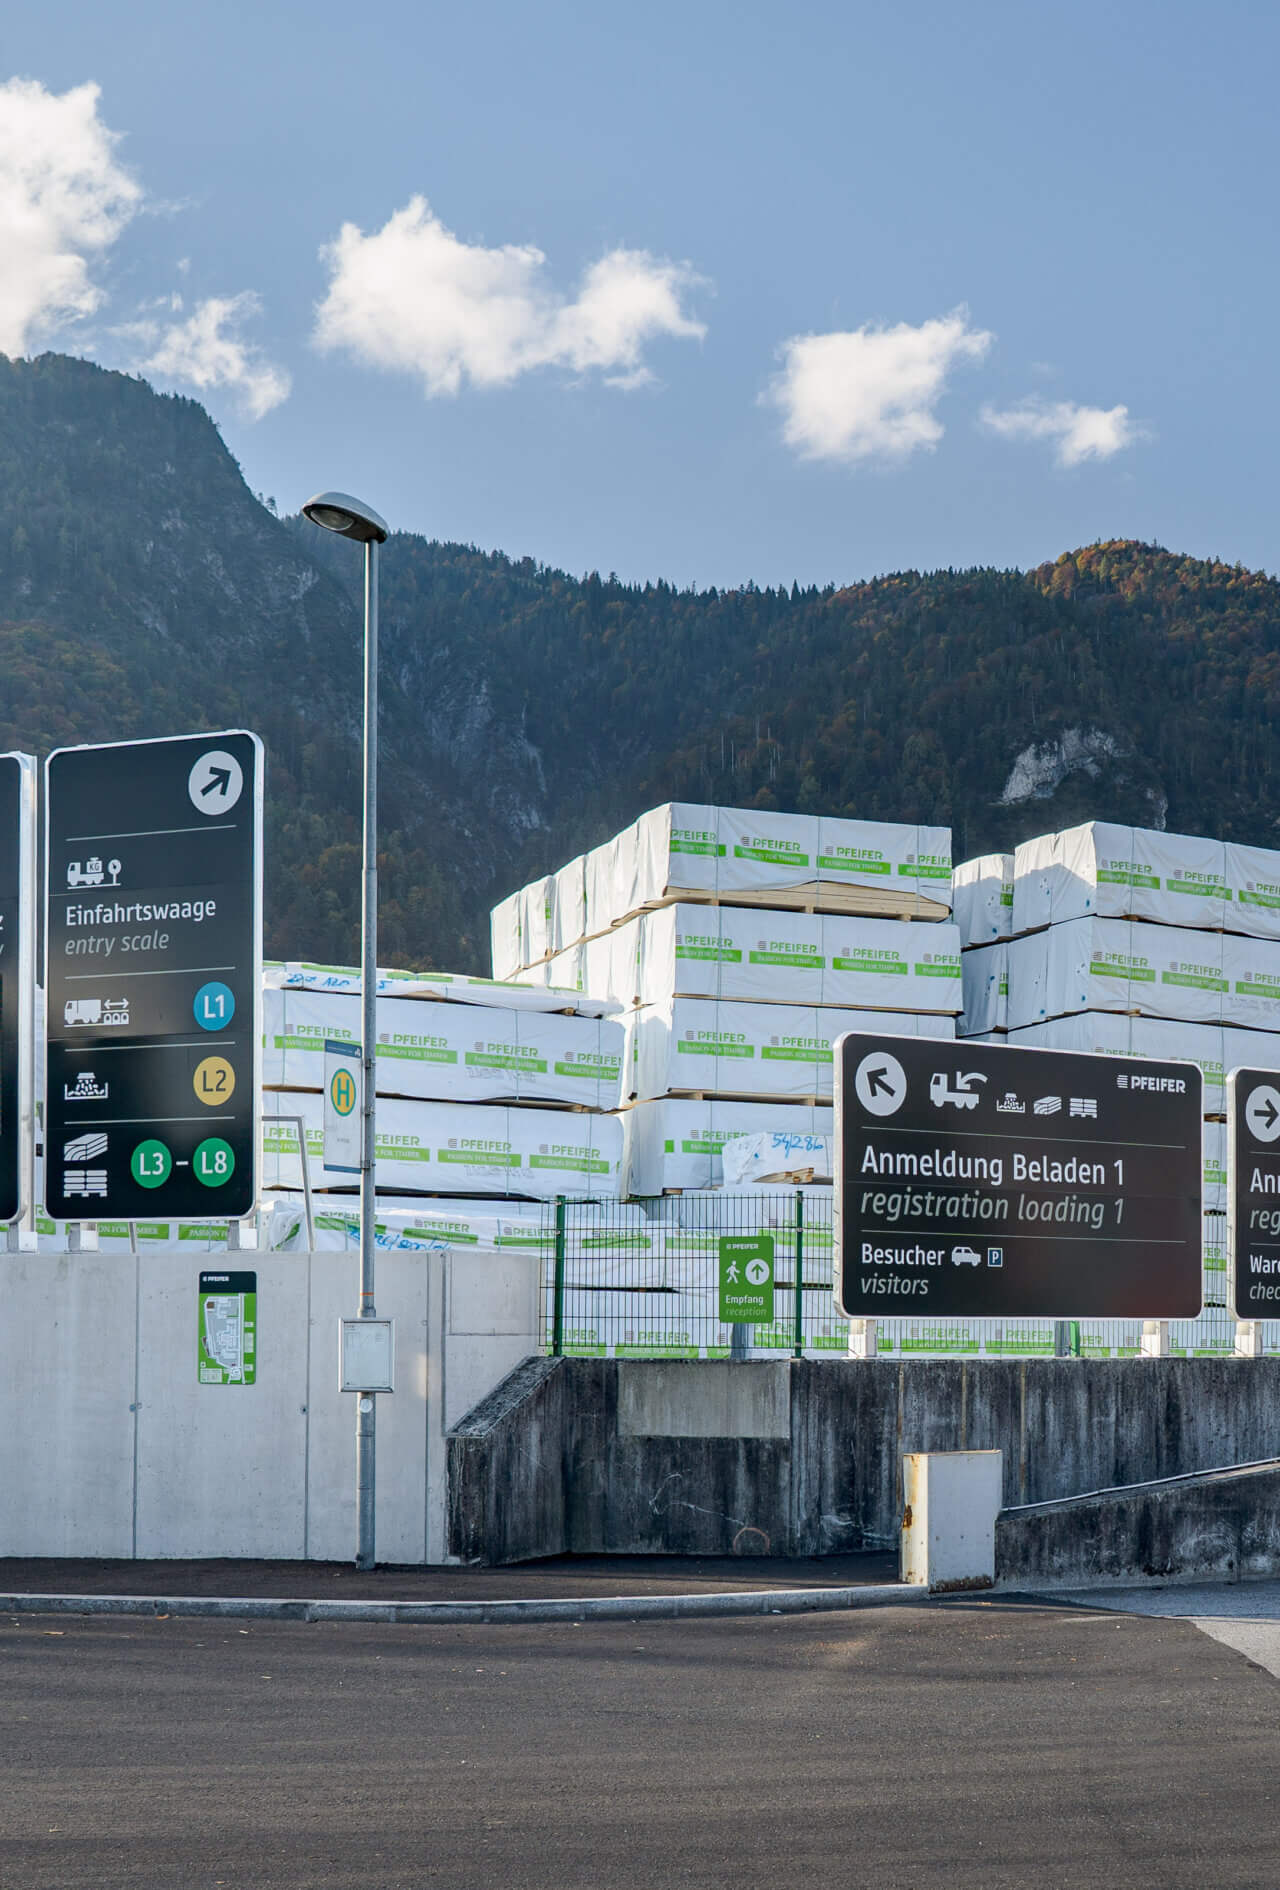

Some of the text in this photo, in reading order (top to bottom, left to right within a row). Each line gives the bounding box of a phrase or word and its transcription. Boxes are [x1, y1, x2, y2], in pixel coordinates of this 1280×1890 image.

[753, 838, 801, 851] PFEIFER
[837, 847, 883, 860] PFEIFER
[66, 900, 217, 926] Einfahrtswaage
[65, 930, 170, 957] entry scale
[685, 935, 733, 947] PFEIFER
[770, 942, 817, 953] PFEIFER
[853, 948, 900, 960] PFEIFER
[1105, 952, 1149, 967] PFEIFER
[1180, 963, 1223, 977] PFEIFER
[204, 994, 225, 1019] L1
[297, 1025, 352, 1038] PFEIFER
[698, 1031, 746, 1043] PFEIFER
[393, 1034, 448, 1048] PFEIFER
[782, 1036, 830, 1048] PFEIFER
[488, 1043, 538, 1056] PFEIFER
[203, 1070, 227, 1092] L2
[1131, 1075, 1186, 1093] PFEIFER
[460, 1139, 512, 1152] PFEIFER
[552, 1144, 600, 1159] PFEIFER
[140, 1152, 164, 1175] L3
[201, 1150, 227, 1174] L8
[861, 1145, 1124, 1186] Anmeldung Beladen 1
[860, 1186, 1124, 1229] registration loading 1
[861, 1243, 945, 1265] Besucher
[861, 1273, 929, 1295] visitors
[726, 1295, 764, 1305] Empfang
[727, 1307, 767, 1317] reception
